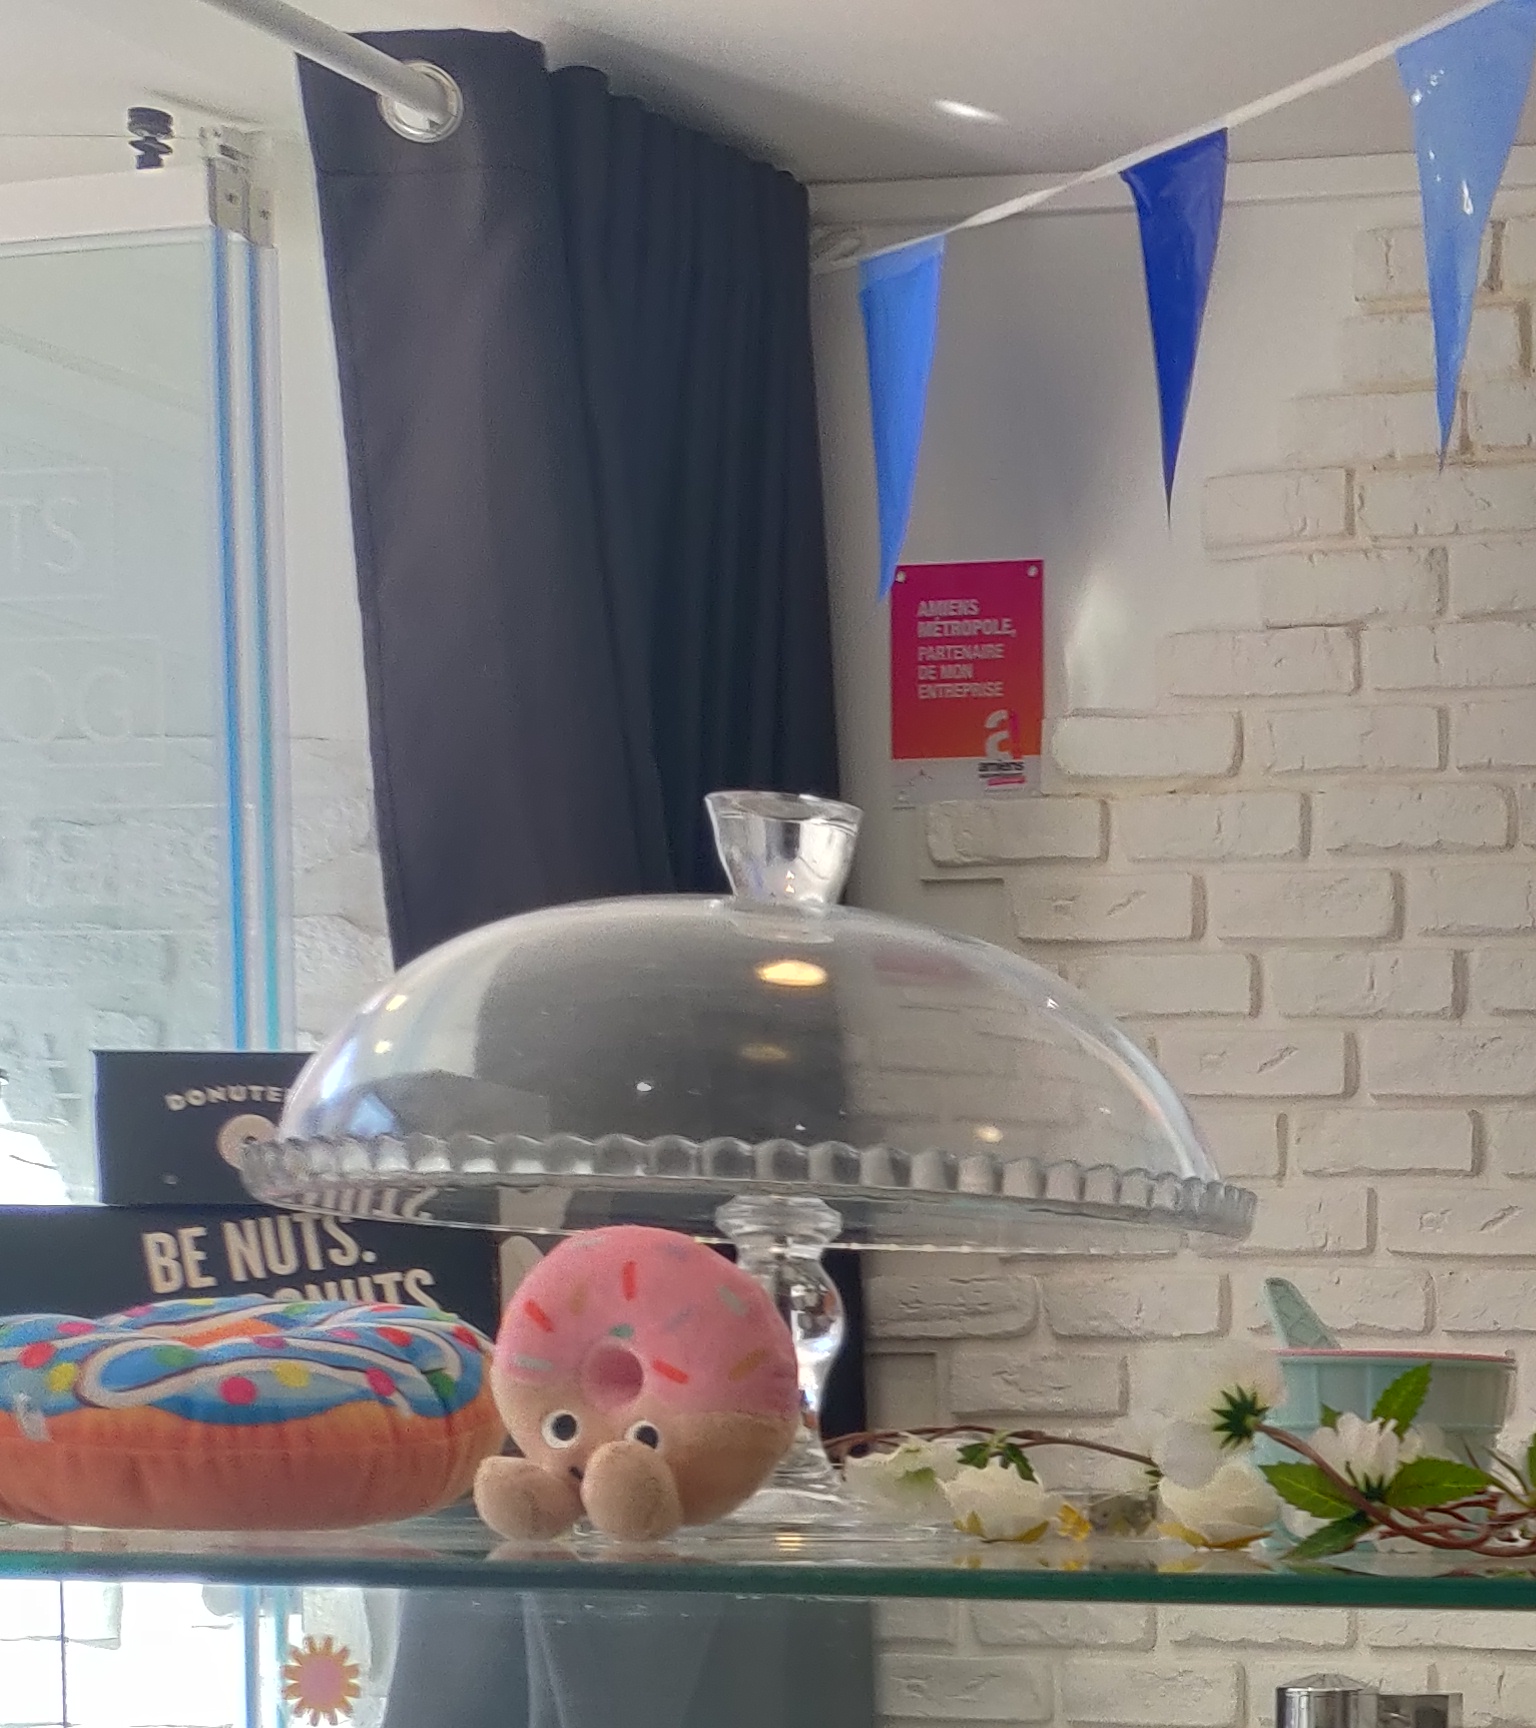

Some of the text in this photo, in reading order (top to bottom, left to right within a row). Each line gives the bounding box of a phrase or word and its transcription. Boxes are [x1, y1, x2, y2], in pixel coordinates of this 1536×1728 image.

[917, 599, 980, 617] AMIENS
[918, 644, 1005, 661] PARTENAIRE
[918, 665, 936, 680] DE
[918, 682, 1004, 699] ENTREPRISE
[142, 1213, 377, 1295] BE NUTS.
